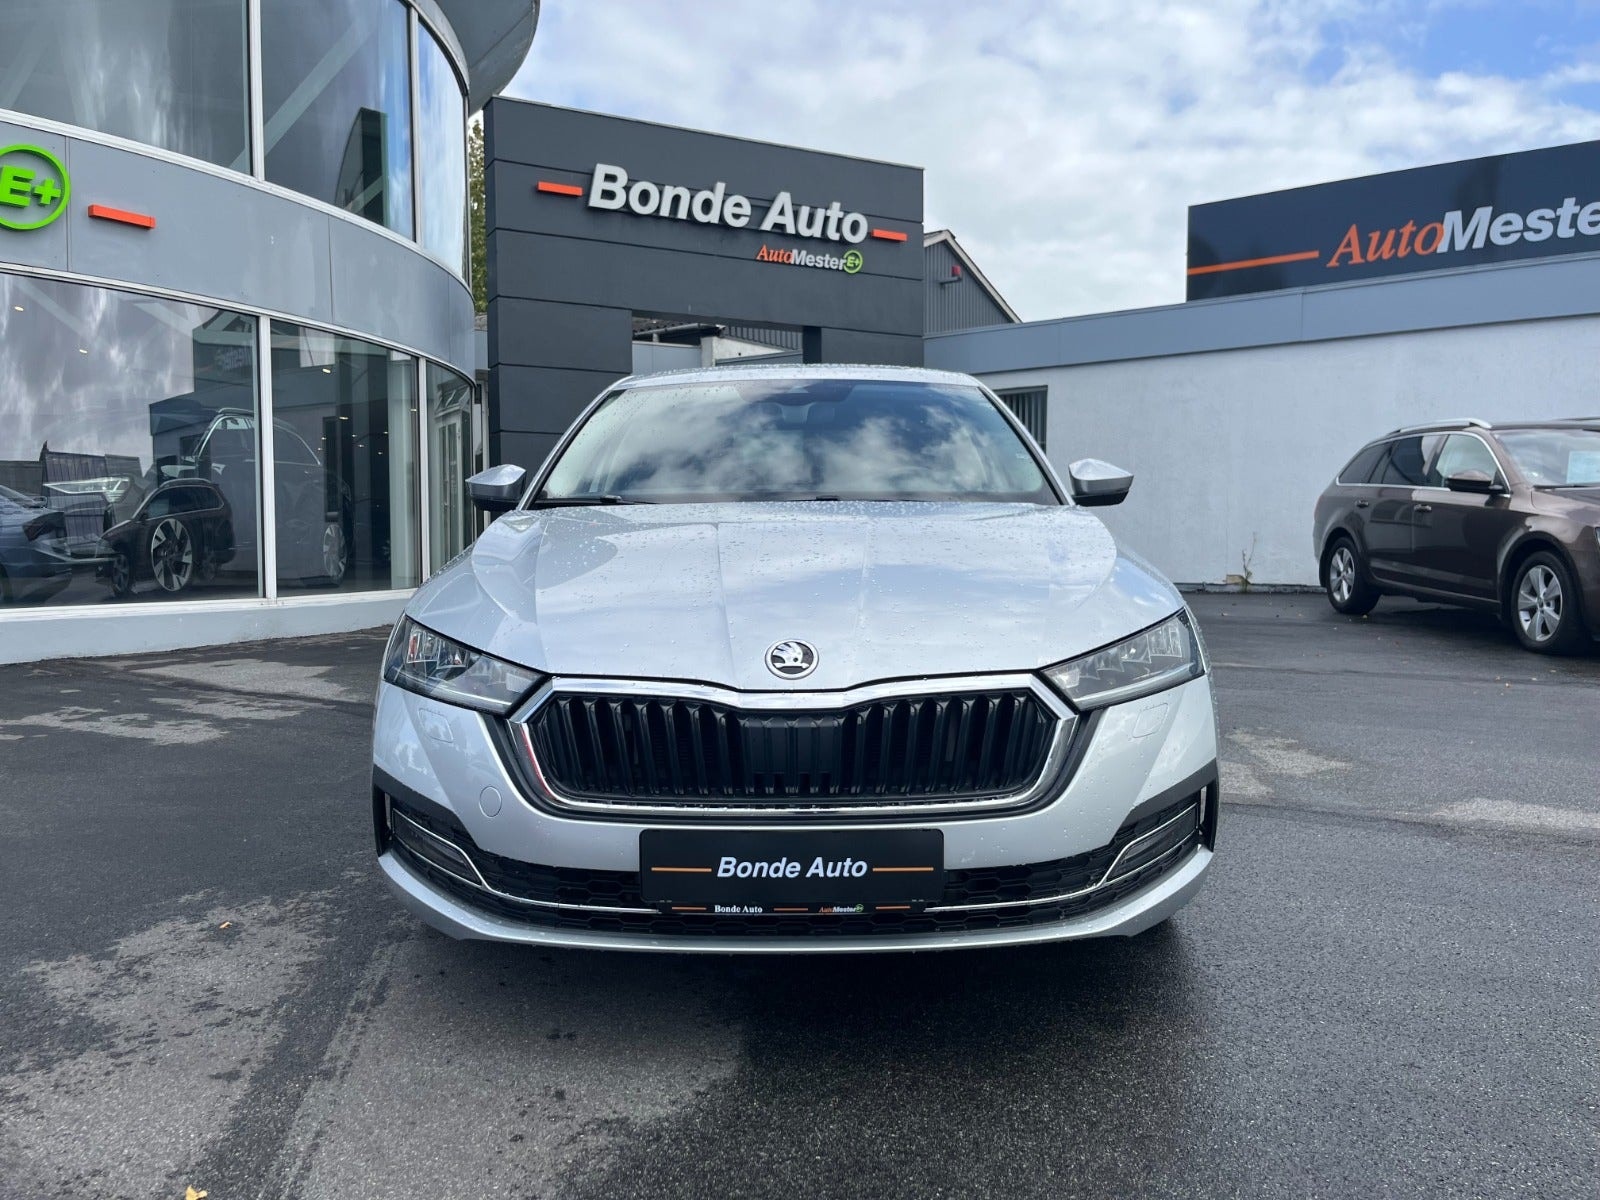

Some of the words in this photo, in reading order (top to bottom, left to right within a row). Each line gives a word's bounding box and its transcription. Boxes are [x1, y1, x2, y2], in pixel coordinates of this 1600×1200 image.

[588, 163, 751, 228] Bonde
[759, 191, 869, 244] Auto
[756, 245, 847, 271] AutoMester
[716, 856, 801, 878] Bonde
[806, 856, 868, 878] Auto
[714, 905, 741, 913] Bonde
[742, 905, 763, 913] Auto
